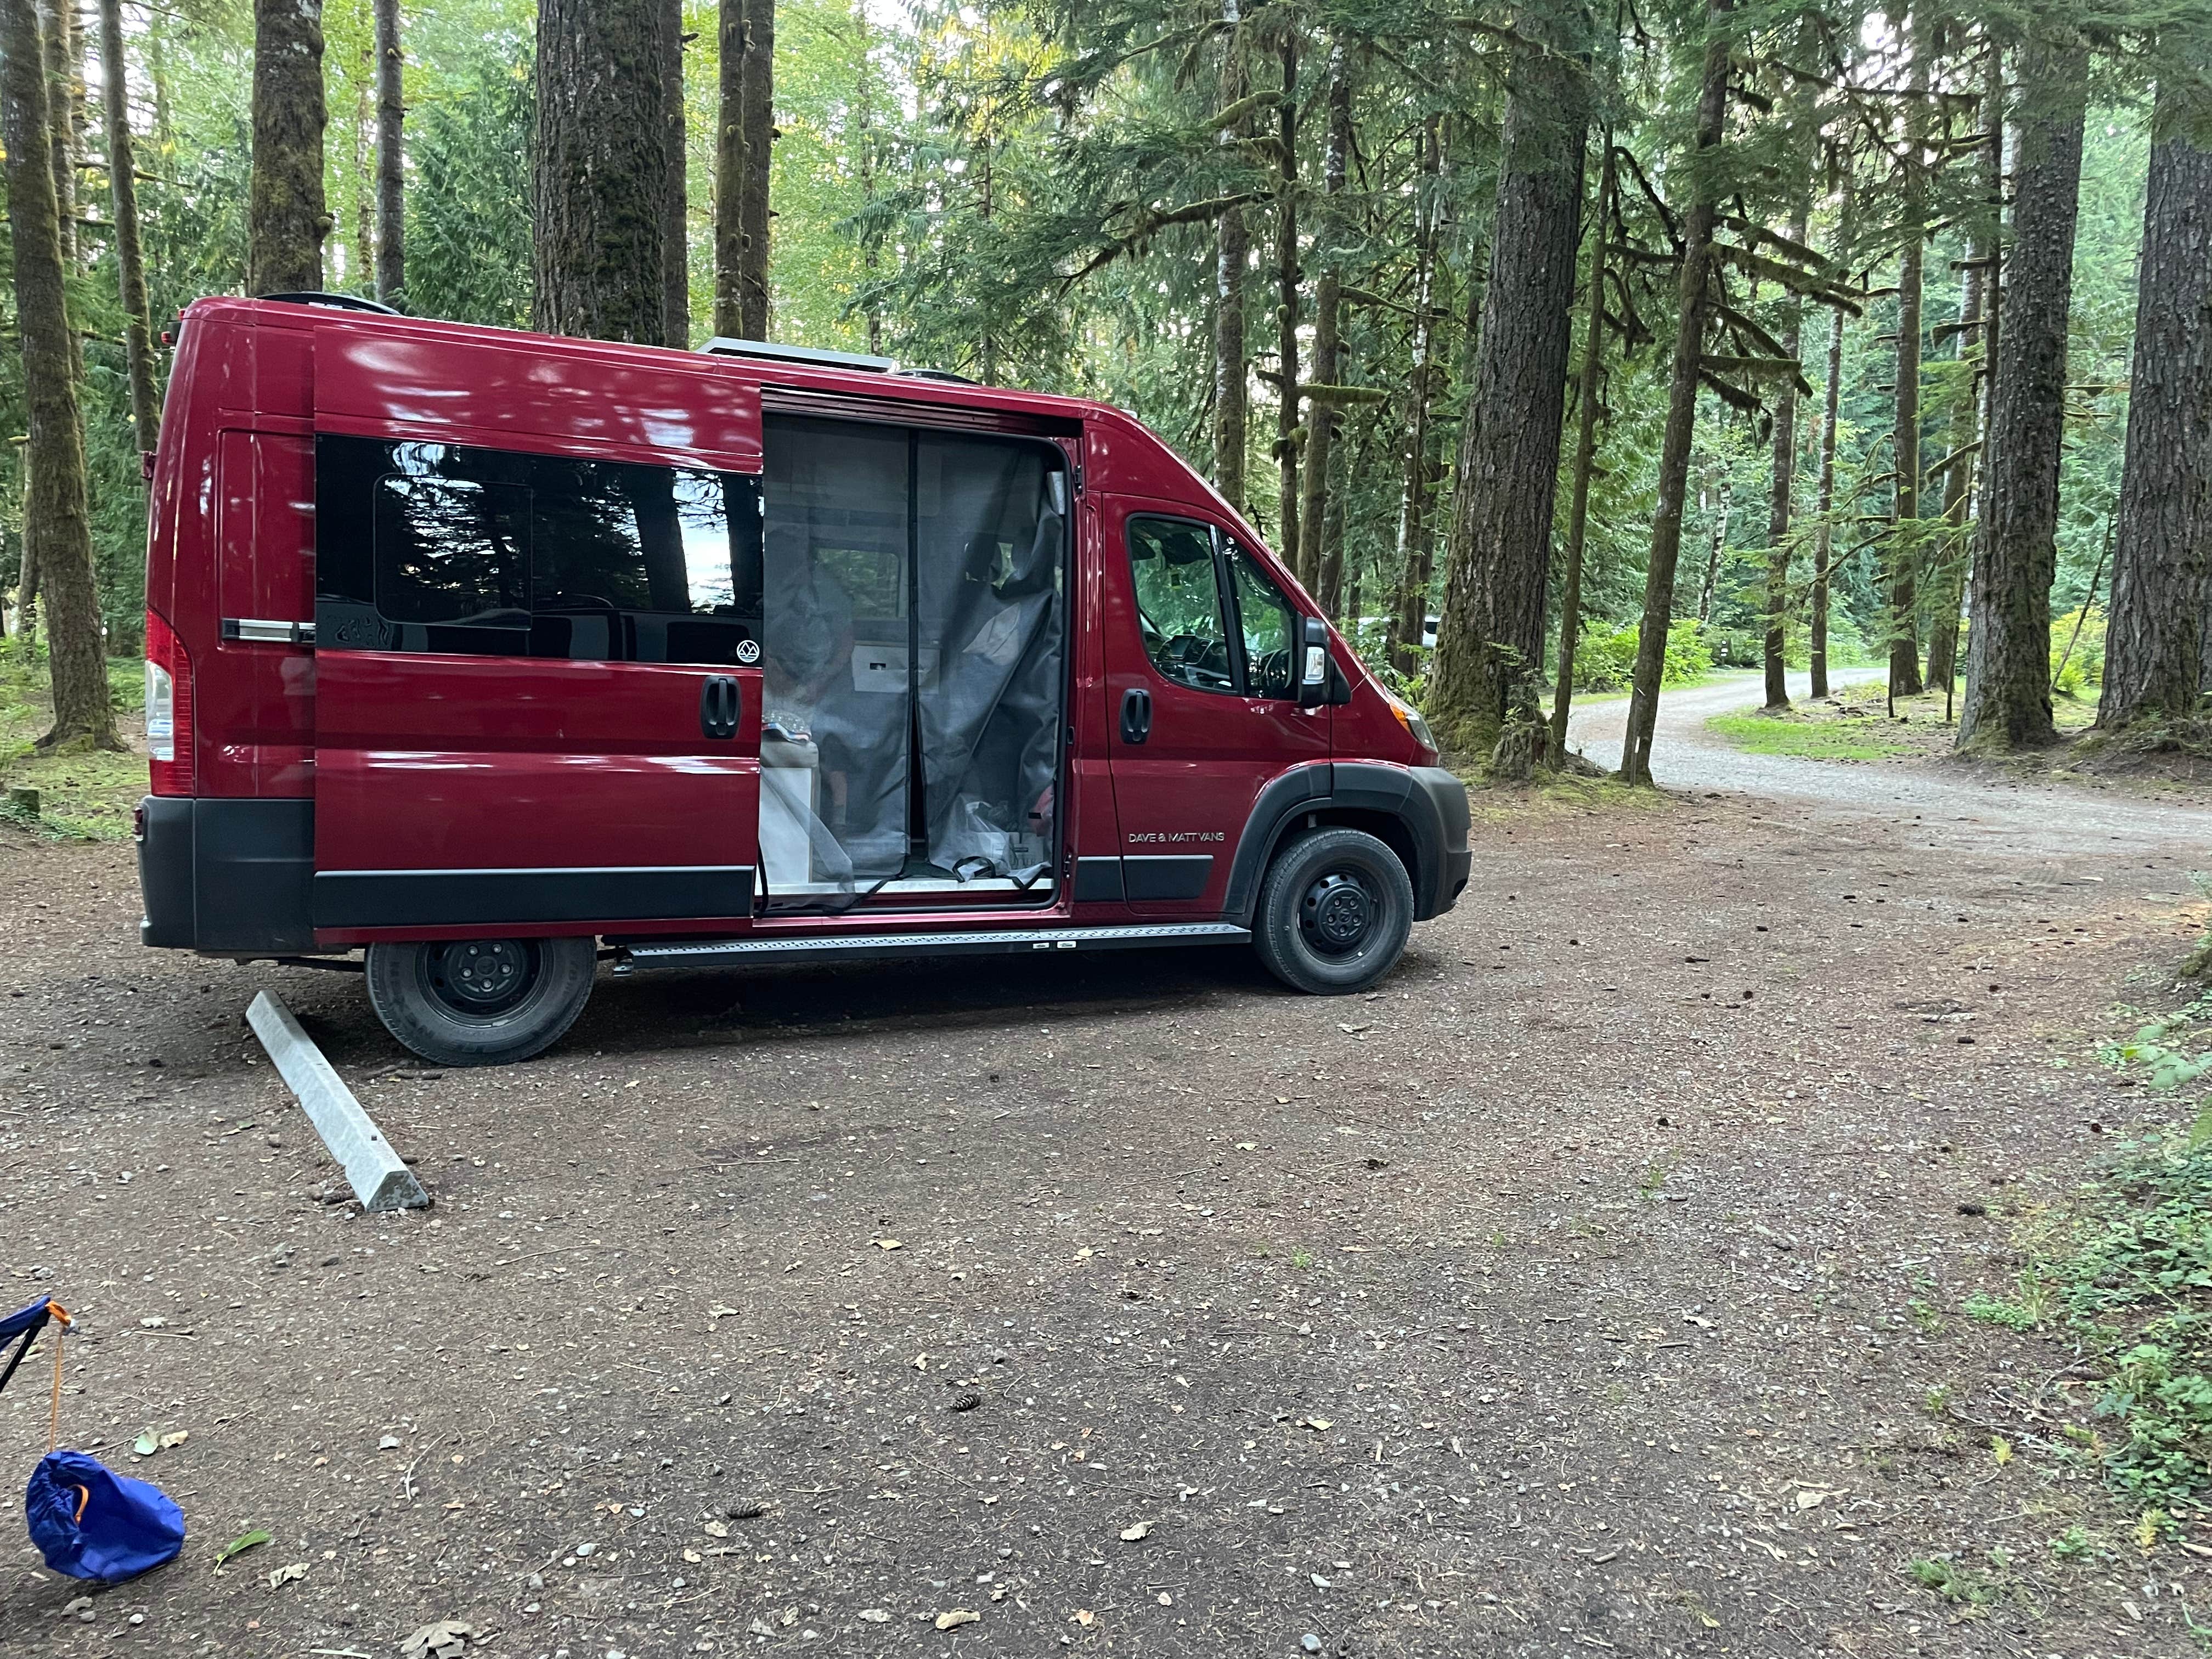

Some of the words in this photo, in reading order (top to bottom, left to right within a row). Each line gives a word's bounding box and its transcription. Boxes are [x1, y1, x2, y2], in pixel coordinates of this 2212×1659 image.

[1128, 833, 1156, 843] DAVE
[1158, 833, 1166, 842] &
[1169, 832, 1197, 842] MATT
[1198, 832, 1224, 842] VANS
